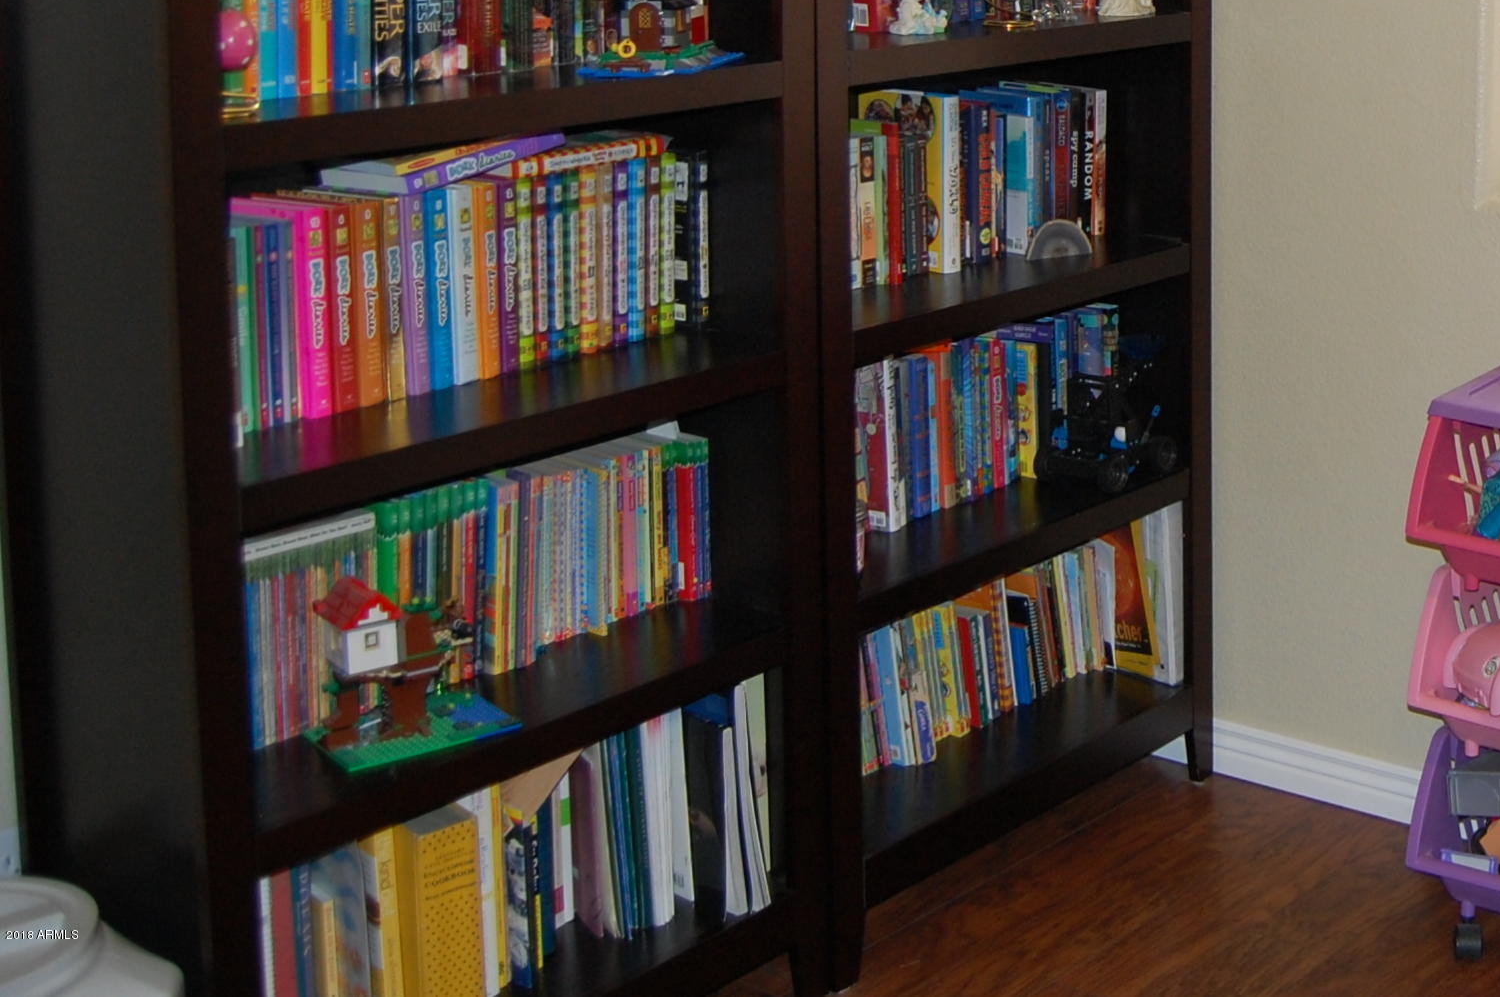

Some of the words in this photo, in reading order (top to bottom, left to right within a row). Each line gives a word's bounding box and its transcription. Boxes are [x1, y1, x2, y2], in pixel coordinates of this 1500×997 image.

[417, 21, 442, 34] EXILE
[1069, 130, 1082, 151] spy
[1069, 153, 1082, 188] camp
[1083, 130, 1096, 201] RANDOM
